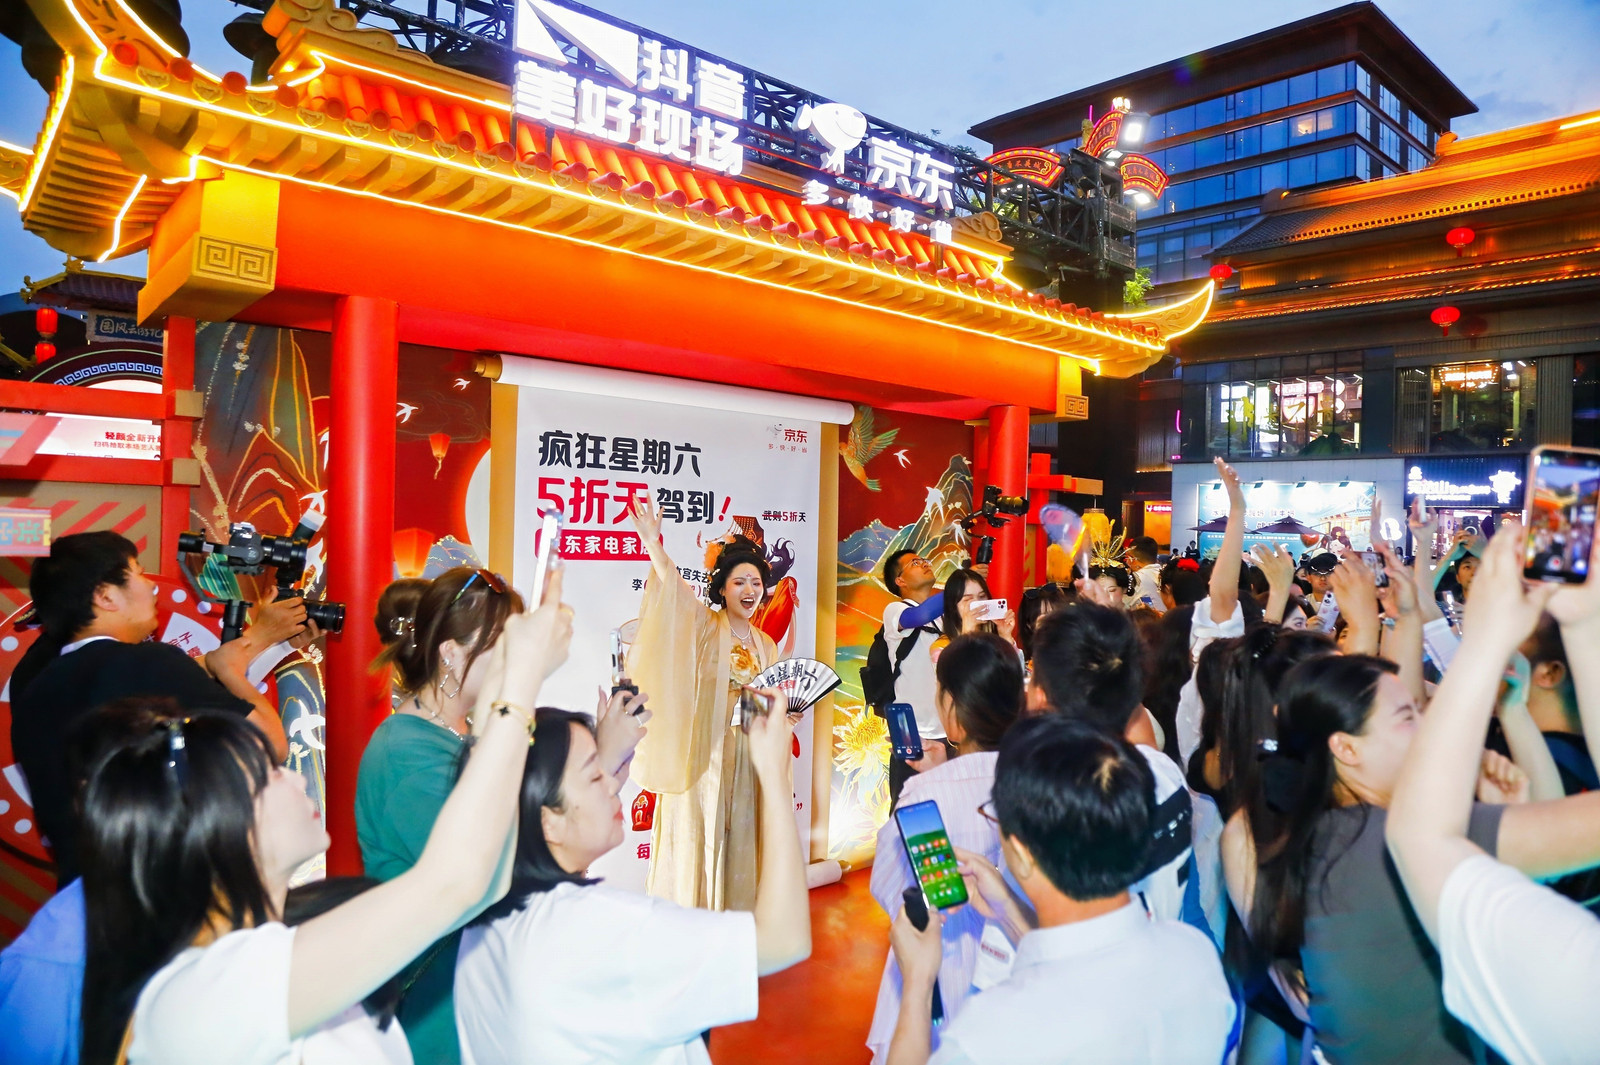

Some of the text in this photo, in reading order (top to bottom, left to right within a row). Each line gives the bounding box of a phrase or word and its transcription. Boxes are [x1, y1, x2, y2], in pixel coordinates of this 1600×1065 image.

[640, 38, 746, 122] 抖音
[512, 60, 744, 177] 美好现场
[865, 136, 956, 210] 京东
[538, 430, 702, 478] 疯狂星期六
[784, 428, 808, 444] 京东
[755, 661, 818, 691] 狂星期六
